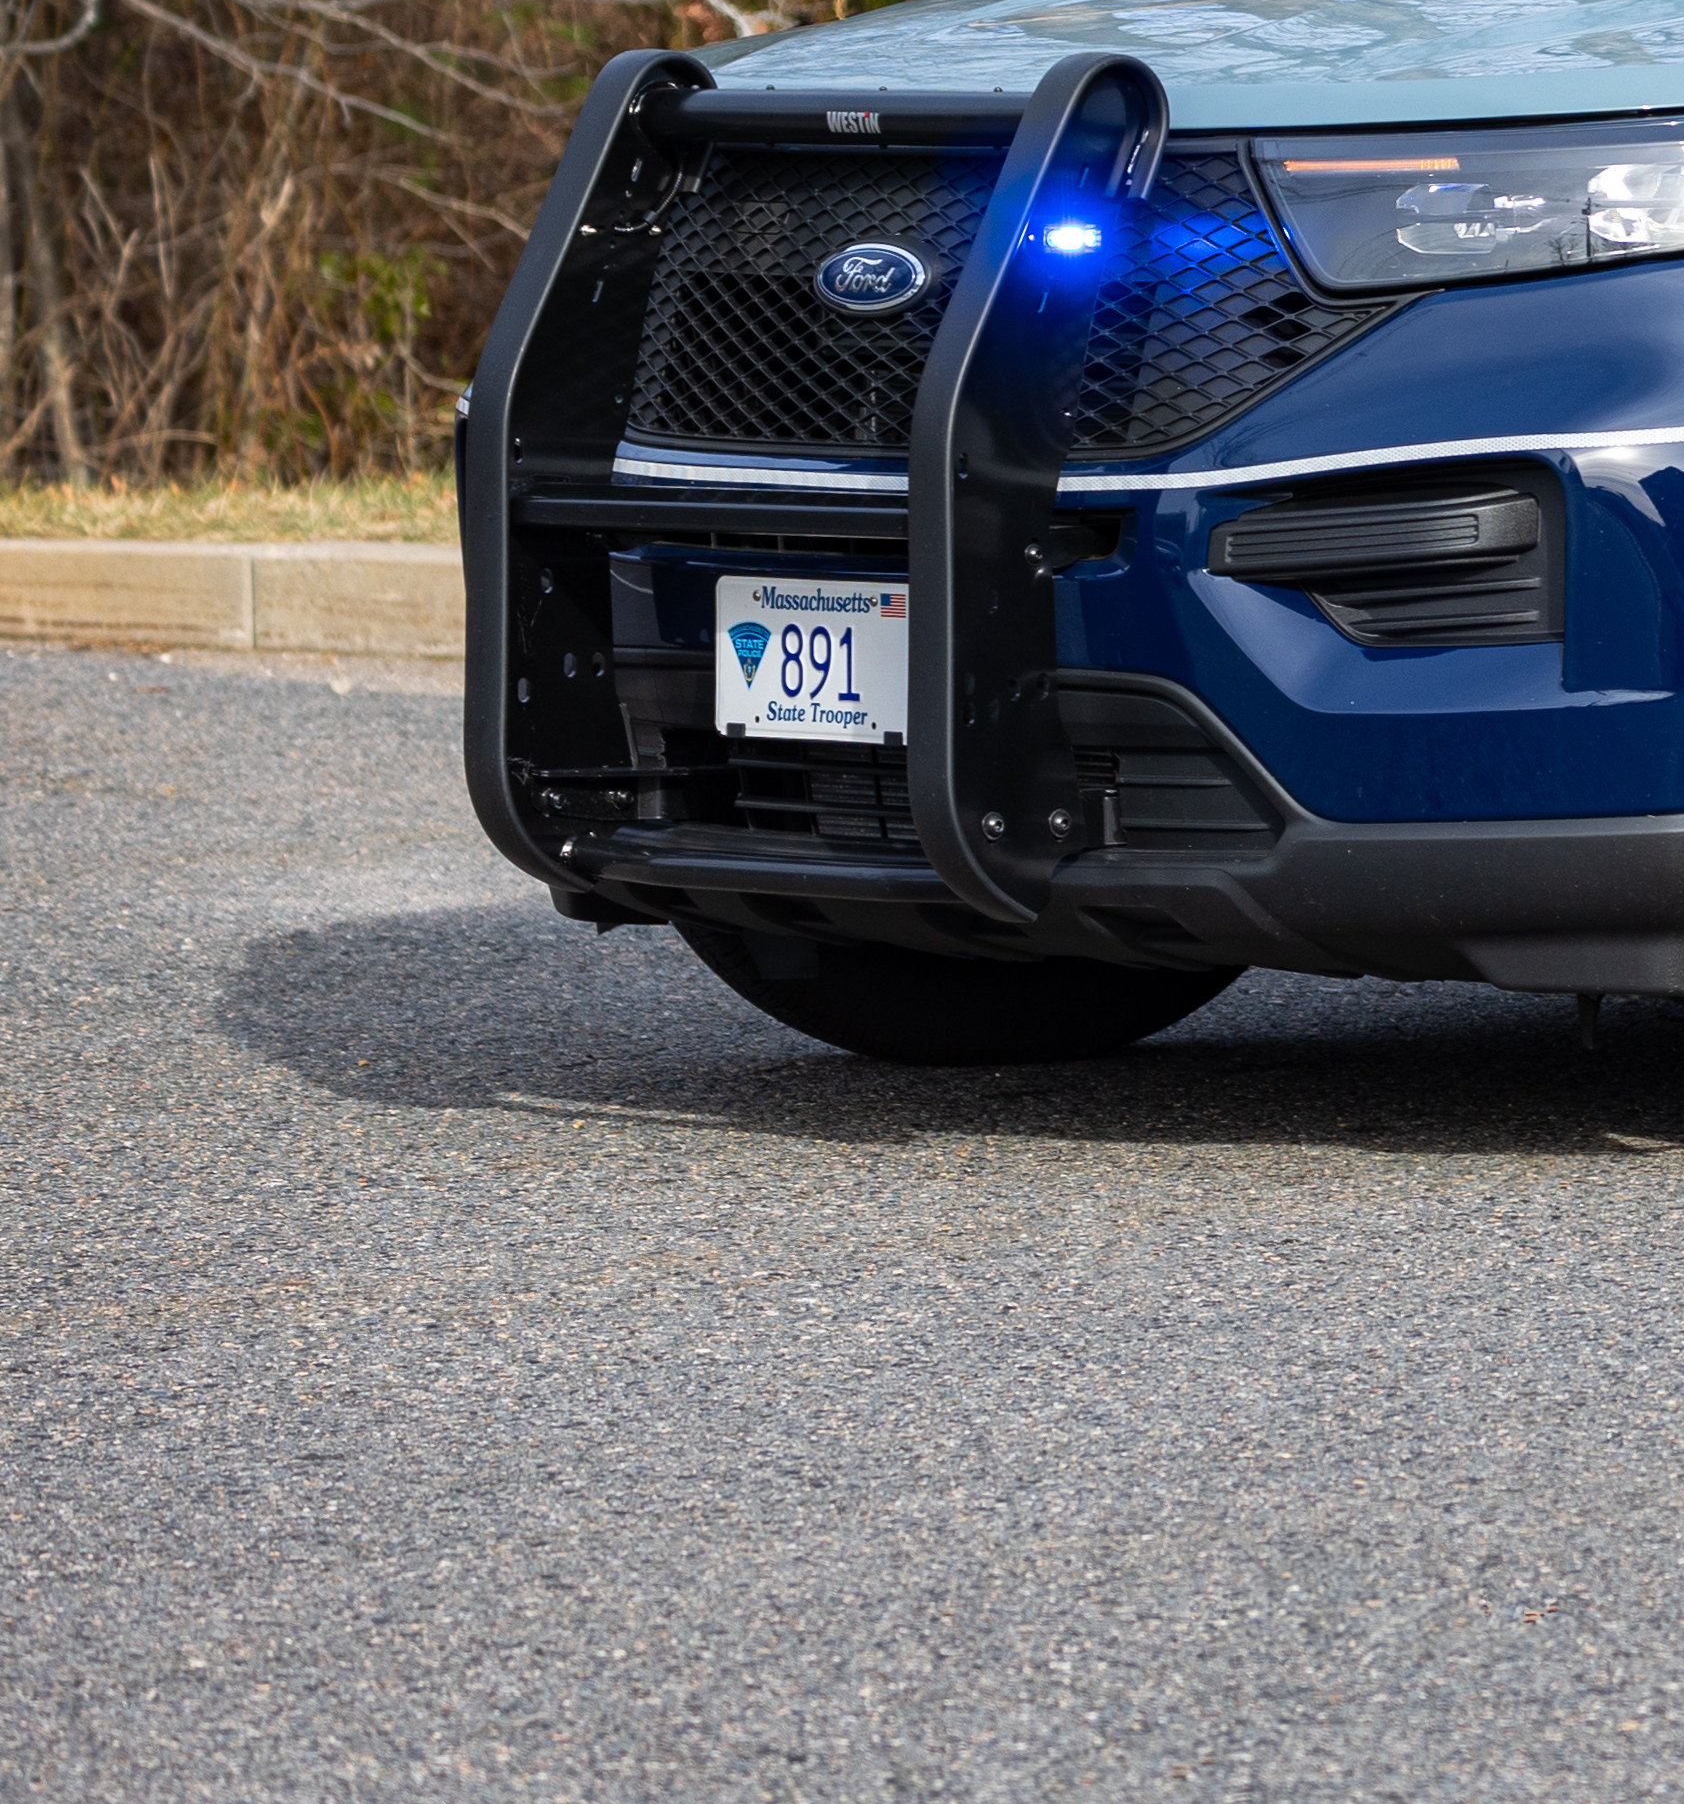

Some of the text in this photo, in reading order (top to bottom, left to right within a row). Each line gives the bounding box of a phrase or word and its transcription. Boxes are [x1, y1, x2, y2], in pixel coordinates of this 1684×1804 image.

[835, 256, 895, 293] Ford
[761, 586, 871, 614] Massachusetts
[735, 639, 764, 650] STATE
[738, 649, 762, 658] POLICE
[781, 623, 861, 702] 891
[766, 700, 868, 729] State Trooper
